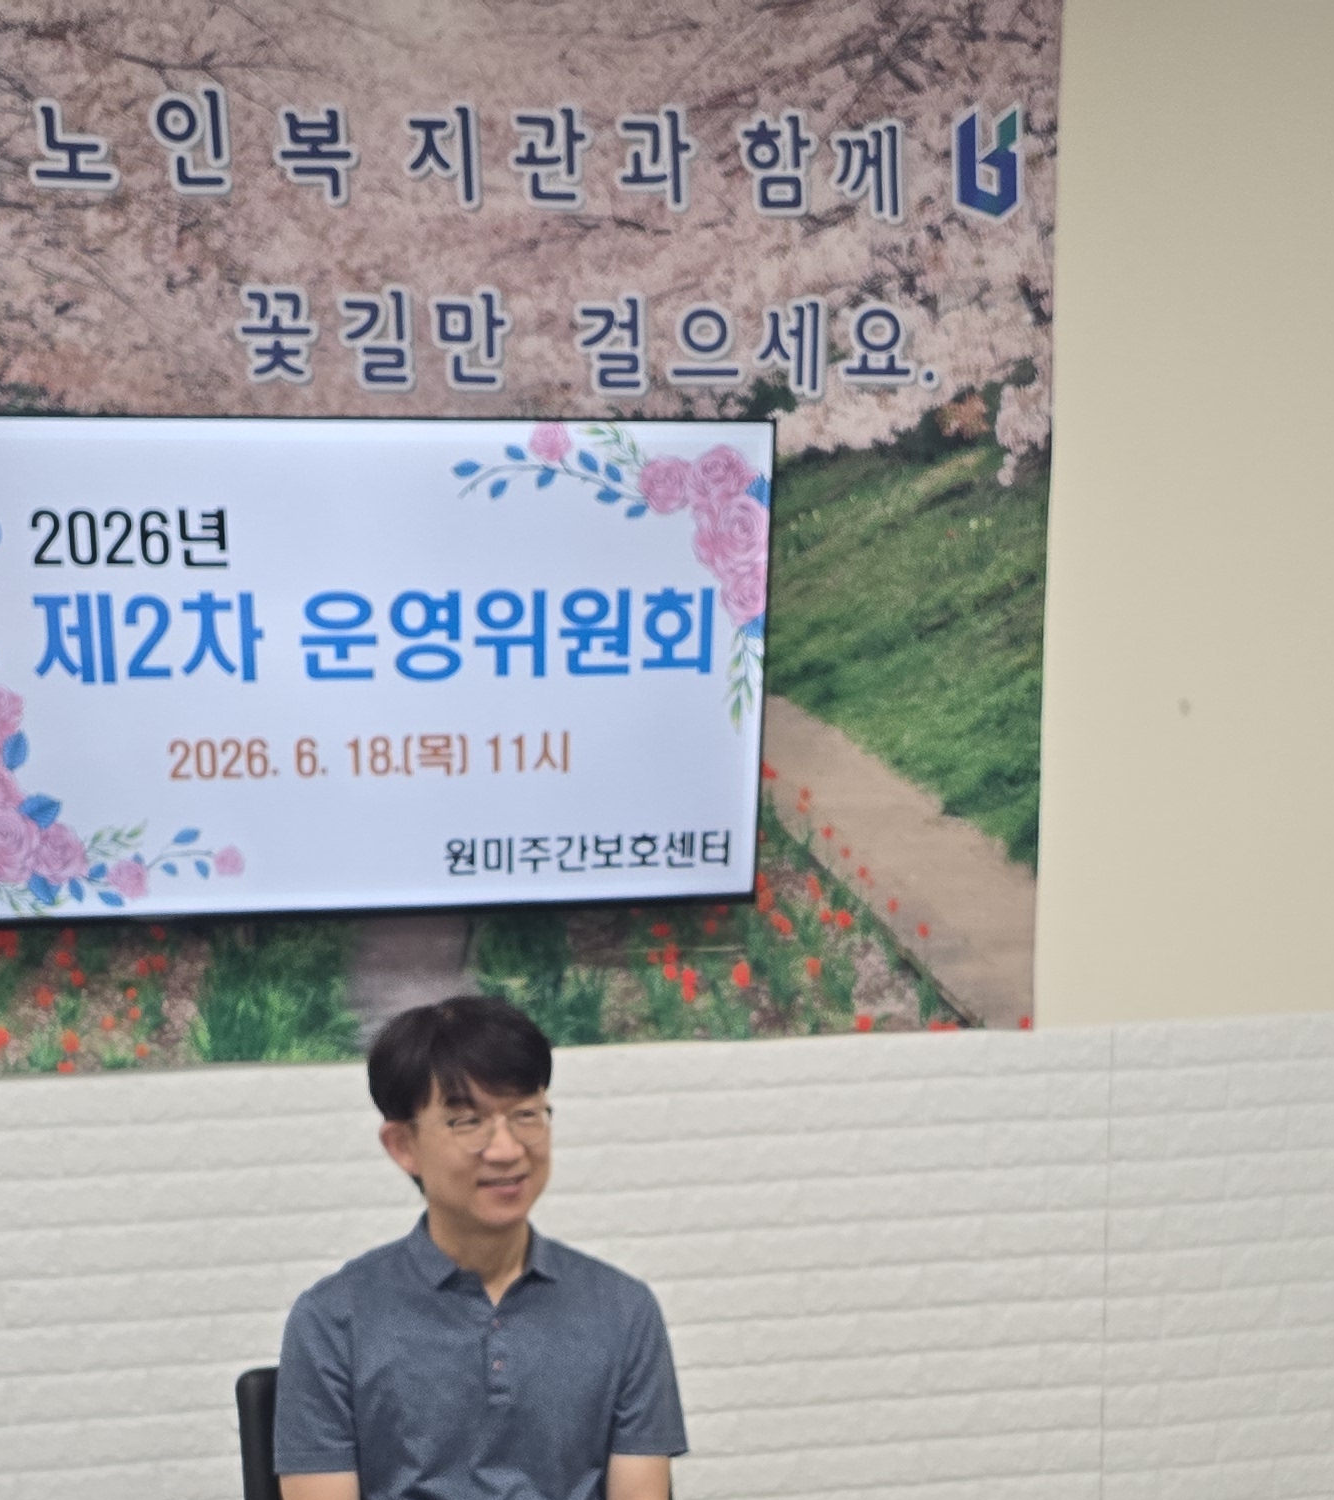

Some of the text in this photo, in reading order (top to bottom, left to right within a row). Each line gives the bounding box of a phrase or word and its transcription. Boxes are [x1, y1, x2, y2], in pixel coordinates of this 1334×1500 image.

[742, 116, 903, 217] 함께
[241, 286, 938, 391] 꽃길만 걸으세요.
[31, 509, 229, 569] 2026년
[32, 588, 715, 685] 제2차 운영위원회
[167, 738, 281, 780] 2026.
[296, 738, 327, 777] 6.
[487, 731, 570, 775] 11시
[444, 832, 732, 877] 원미주간보호센터
